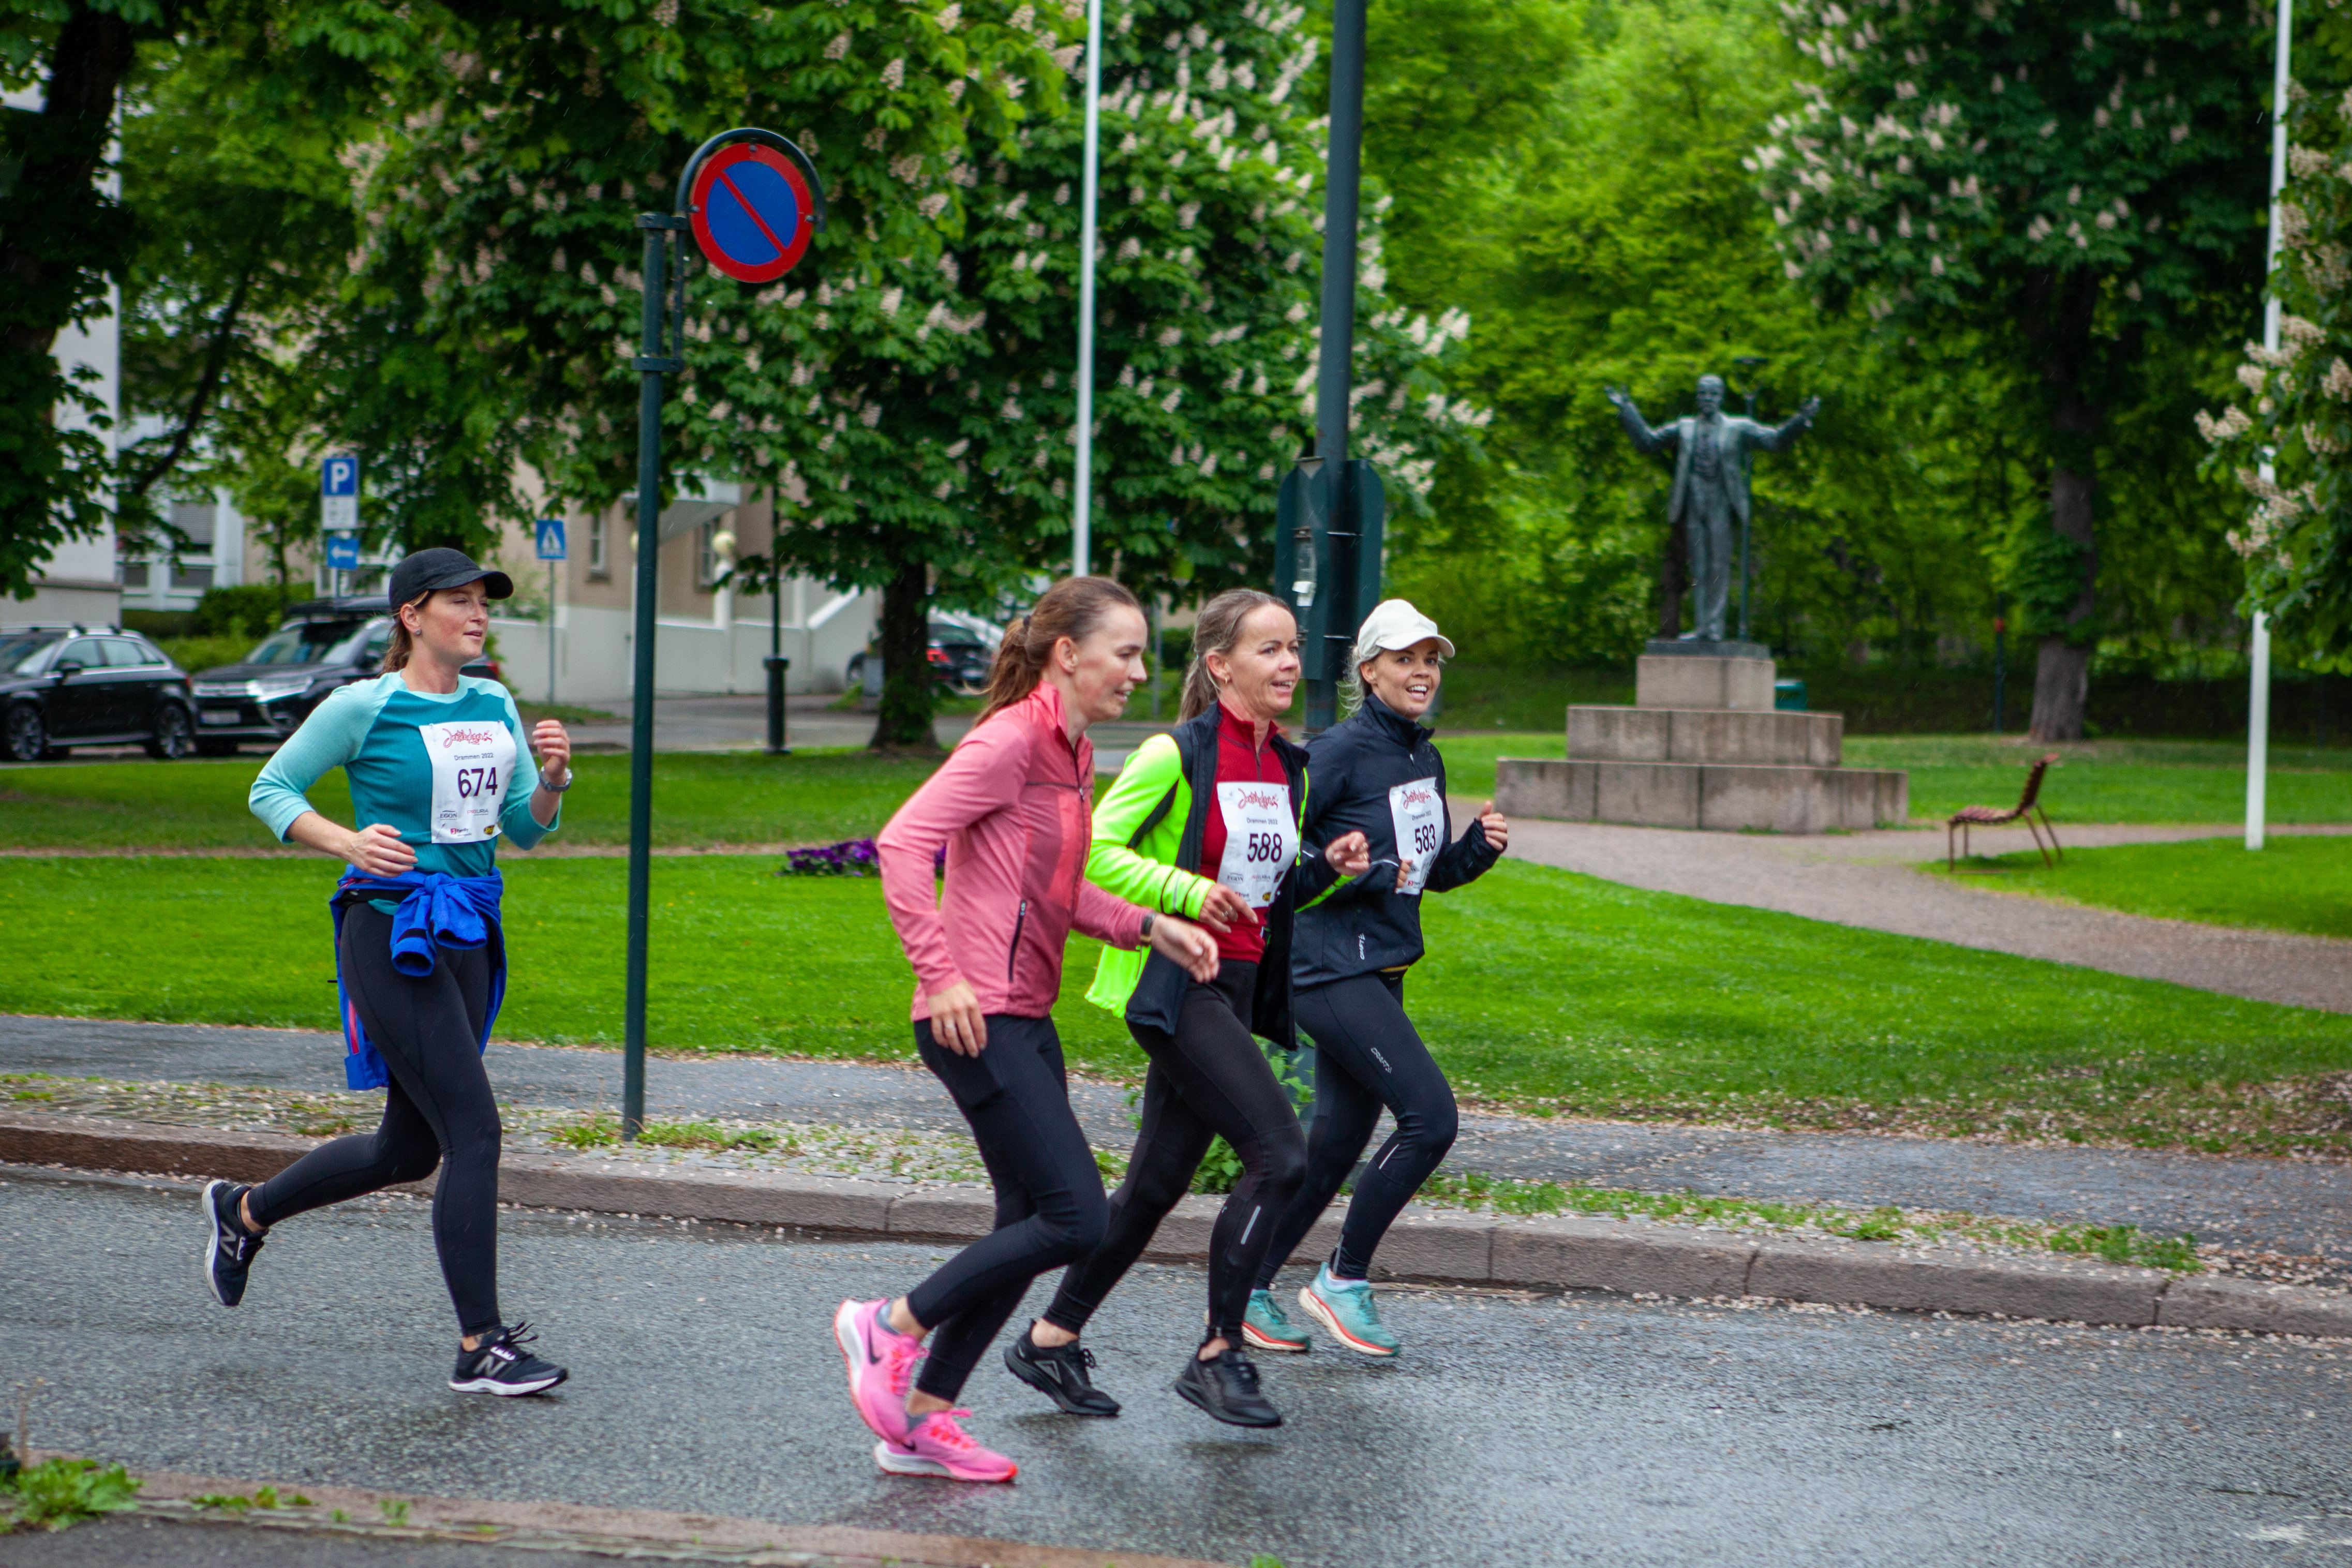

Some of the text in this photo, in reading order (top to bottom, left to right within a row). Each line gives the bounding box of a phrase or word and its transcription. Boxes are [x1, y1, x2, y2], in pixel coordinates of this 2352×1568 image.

[330, 461, 350, 492] P
[457, 767, 498, 798] 674
[1247, 833, 1282, 863] 588
[1415, 824, 1436, 855] 583
[1371, 1047, 1390, 1068] CRAFT
